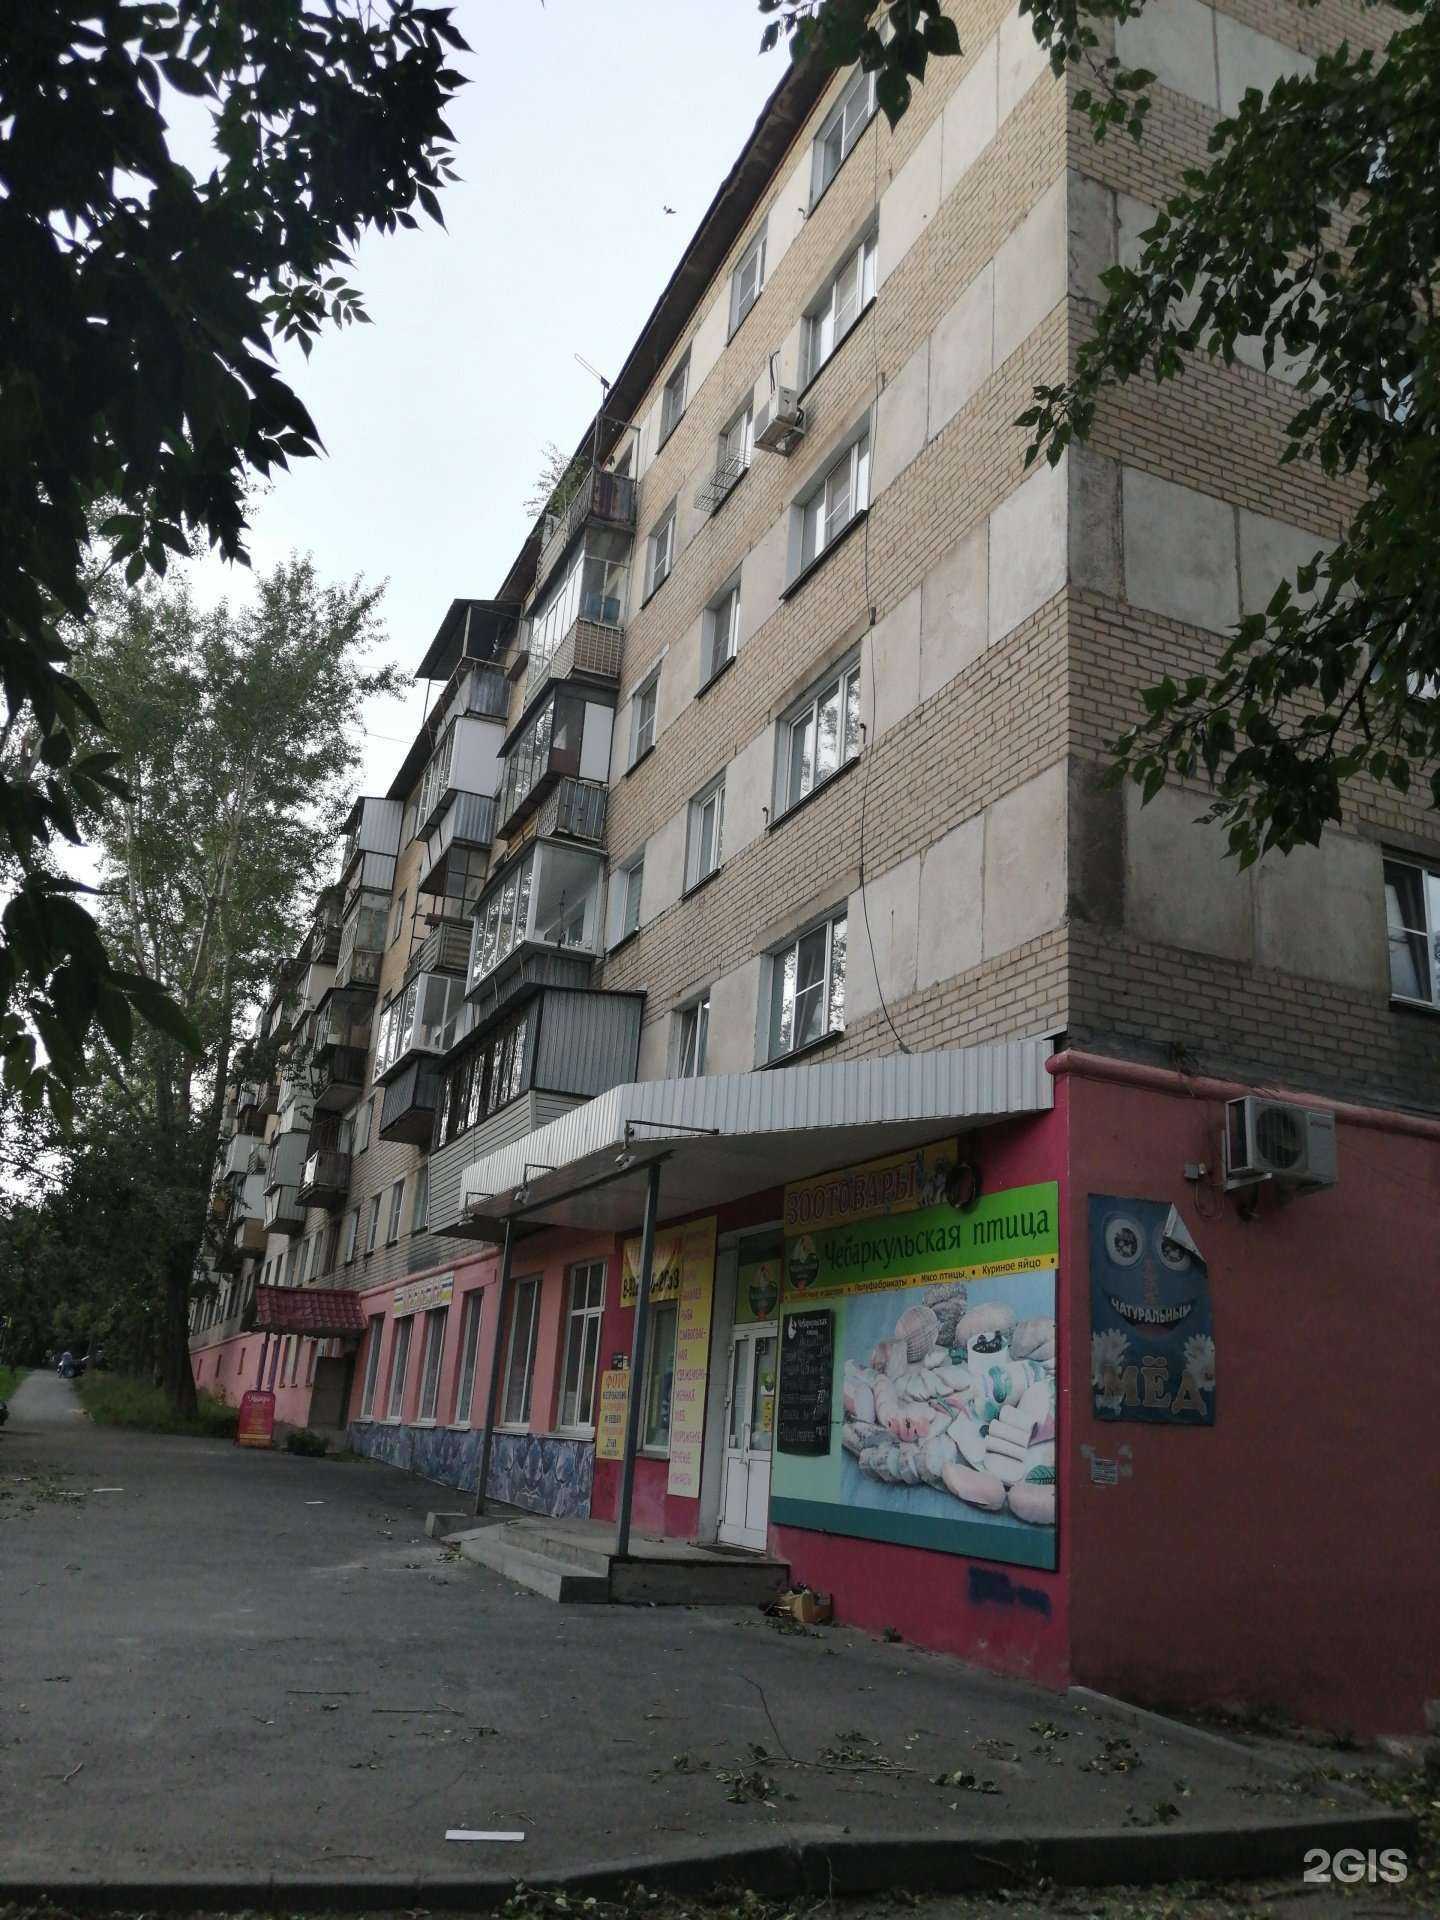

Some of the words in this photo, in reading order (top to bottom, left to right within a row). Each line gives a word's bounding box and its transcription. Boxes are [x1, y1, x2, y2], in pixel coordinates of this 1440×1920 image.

[823, 1222, 961, 1272] Чебаркульская
[973, 1209, 1050, 1246] птица
[981, 1260, 1016, 1276] Куриное
[1017, 1257, 1042, 1271] яйцо
[1102, 1354, 1208, 1417] МЁД
